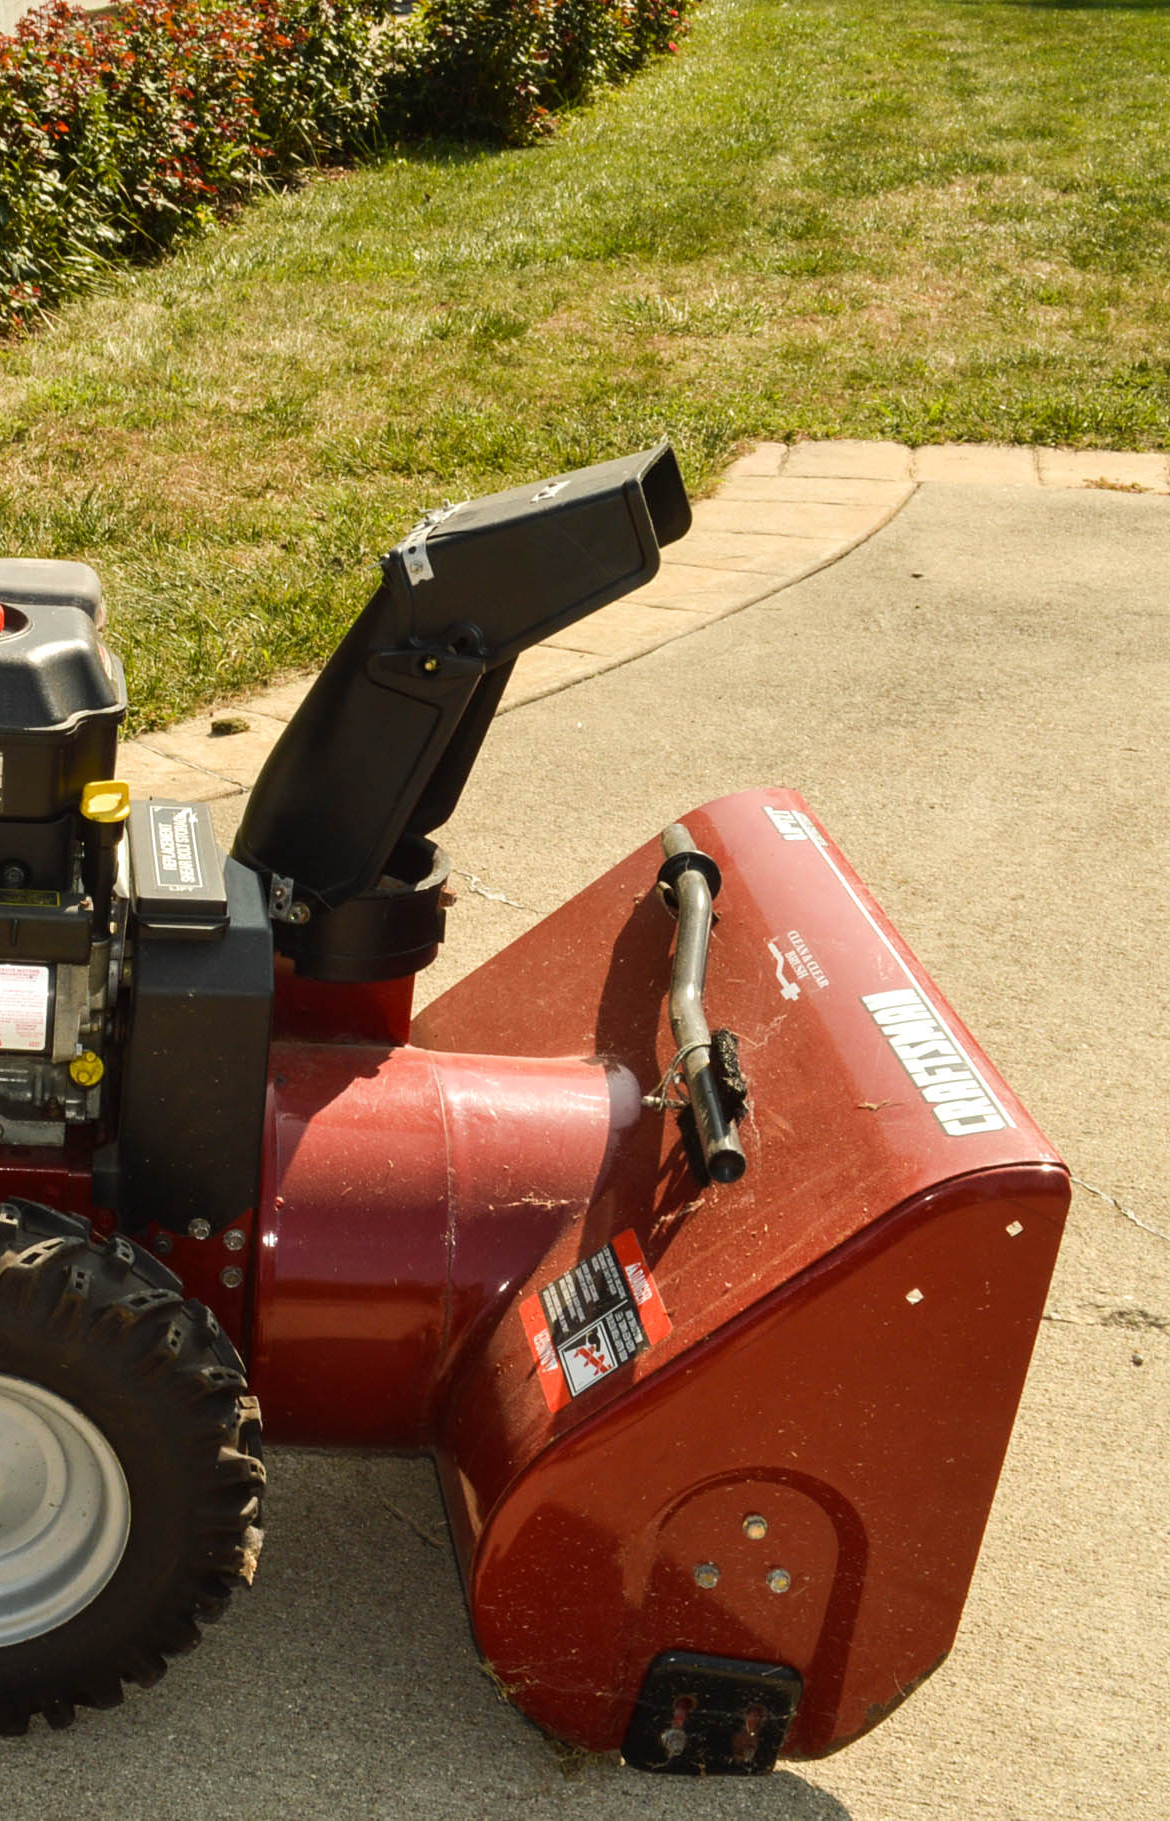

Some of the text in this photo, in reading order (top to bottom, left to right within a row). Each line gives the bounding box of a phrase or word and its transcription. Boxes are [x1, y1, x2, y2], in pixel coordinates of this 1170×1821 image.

[784, 950, 809, 979] BRUSH
[787, 930, 810, 956] CLEAN
[806, 960, 830, 989] CLEAR
[861, 987, 1006, 1137] CRAFTSMAN
